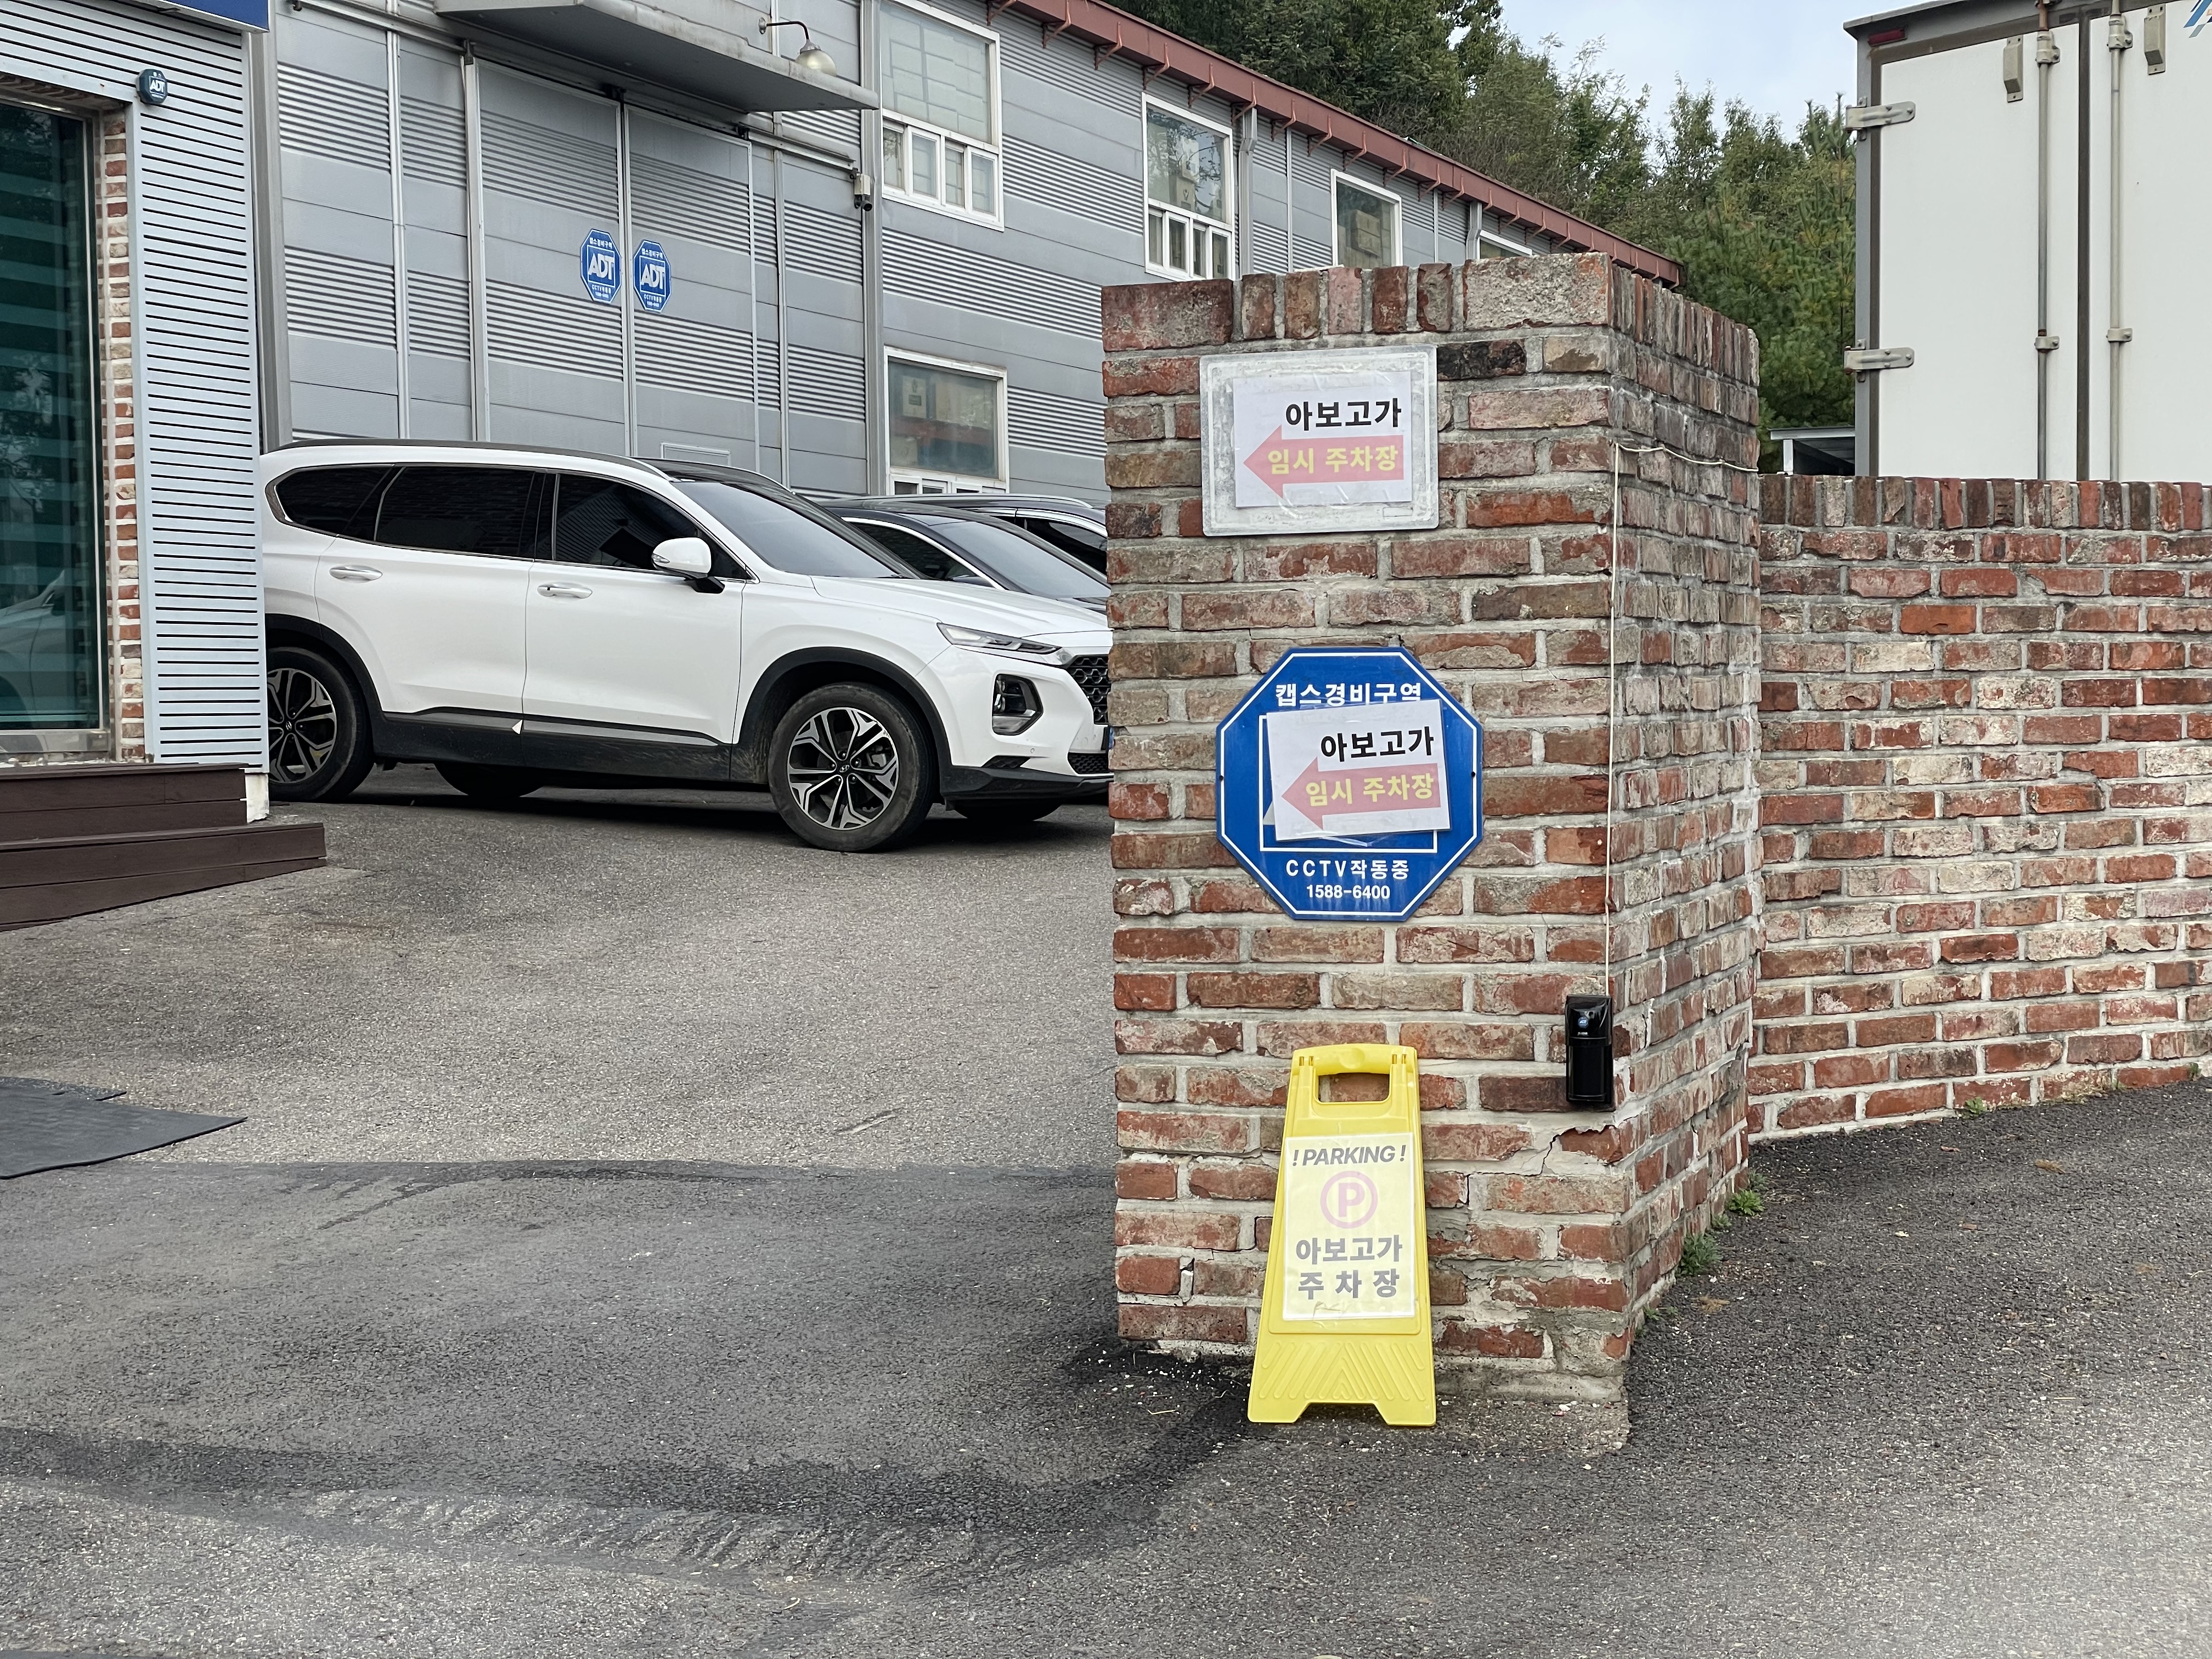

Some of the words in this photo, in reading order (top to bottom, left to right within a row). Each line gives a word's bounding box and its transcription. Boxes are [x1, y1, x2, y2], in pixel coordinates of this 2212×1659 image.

[150, 80, 165, 92] ADT
[588, 253, 614, 280] ADT
[640, 263, 665, 289] ADT
[1285, 398, 1402, 431] 아보고가
[1268, 448, 1314, 475] 임시
[1325, 445, 1398, 473] 주차장
[1276, 682, 1421, 707] 캡스경비구역
[1321, 726, 1434, 763] 아보고가
[1305, 778, 1353, 807] 임시
[1363, 773, 1434, 803] 주차장
[1285, 859, 1409, 879] CCTV작동중
[1306, 885, 1390, 899] 1588-6400
[1296, 1234, 1403, 1265] 아보고가
